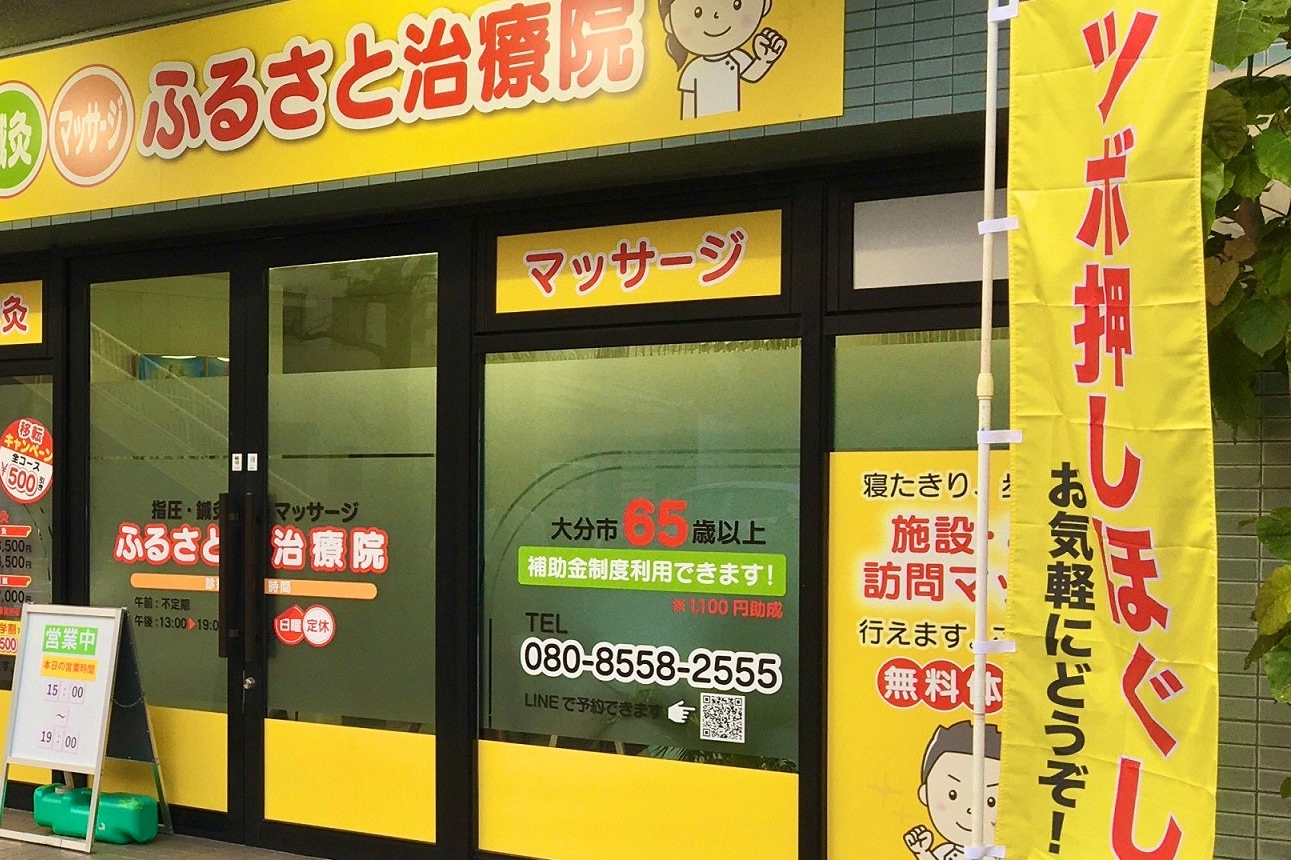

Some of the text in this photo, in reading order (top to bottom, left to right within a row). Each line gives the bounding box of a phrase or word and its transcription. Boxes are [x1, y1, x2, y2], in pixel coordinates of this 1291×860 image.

[140, 0, 635, 154] ふるさと治療院
[58, 96, 123, 157] マッサージ
[523, 228, 746, 296] マッサージ
[4, 433, 53, 462] キャンペーン
[1072, 9, 1186, 860] ツボ押しほぐし
[11, 453, 40, 472] 全コース
[274, 502, 359, 522] マッサージ
[550, 497, 767, 547] 大分市65歳以上
[114, 523, 219, 565] ふるさと
[272, 525, 388, 573] 治療院
[891, 515, 1010, 554] 施設・
[527, 556, 774, 586] 補助金制度利用できます!
[45, 628, 96, 651] 営業中
[197, 618, 219, 631] 19:0
[306, 619, 330, 634] 定休
[525, 612, 568, 634] TEL
[43, 660, 95, 676] 本日の営業時間
[523, 641, 779, 690] 080-8558-2555
[1038, 461, 1096, 854] お気軽にどうぞ!
